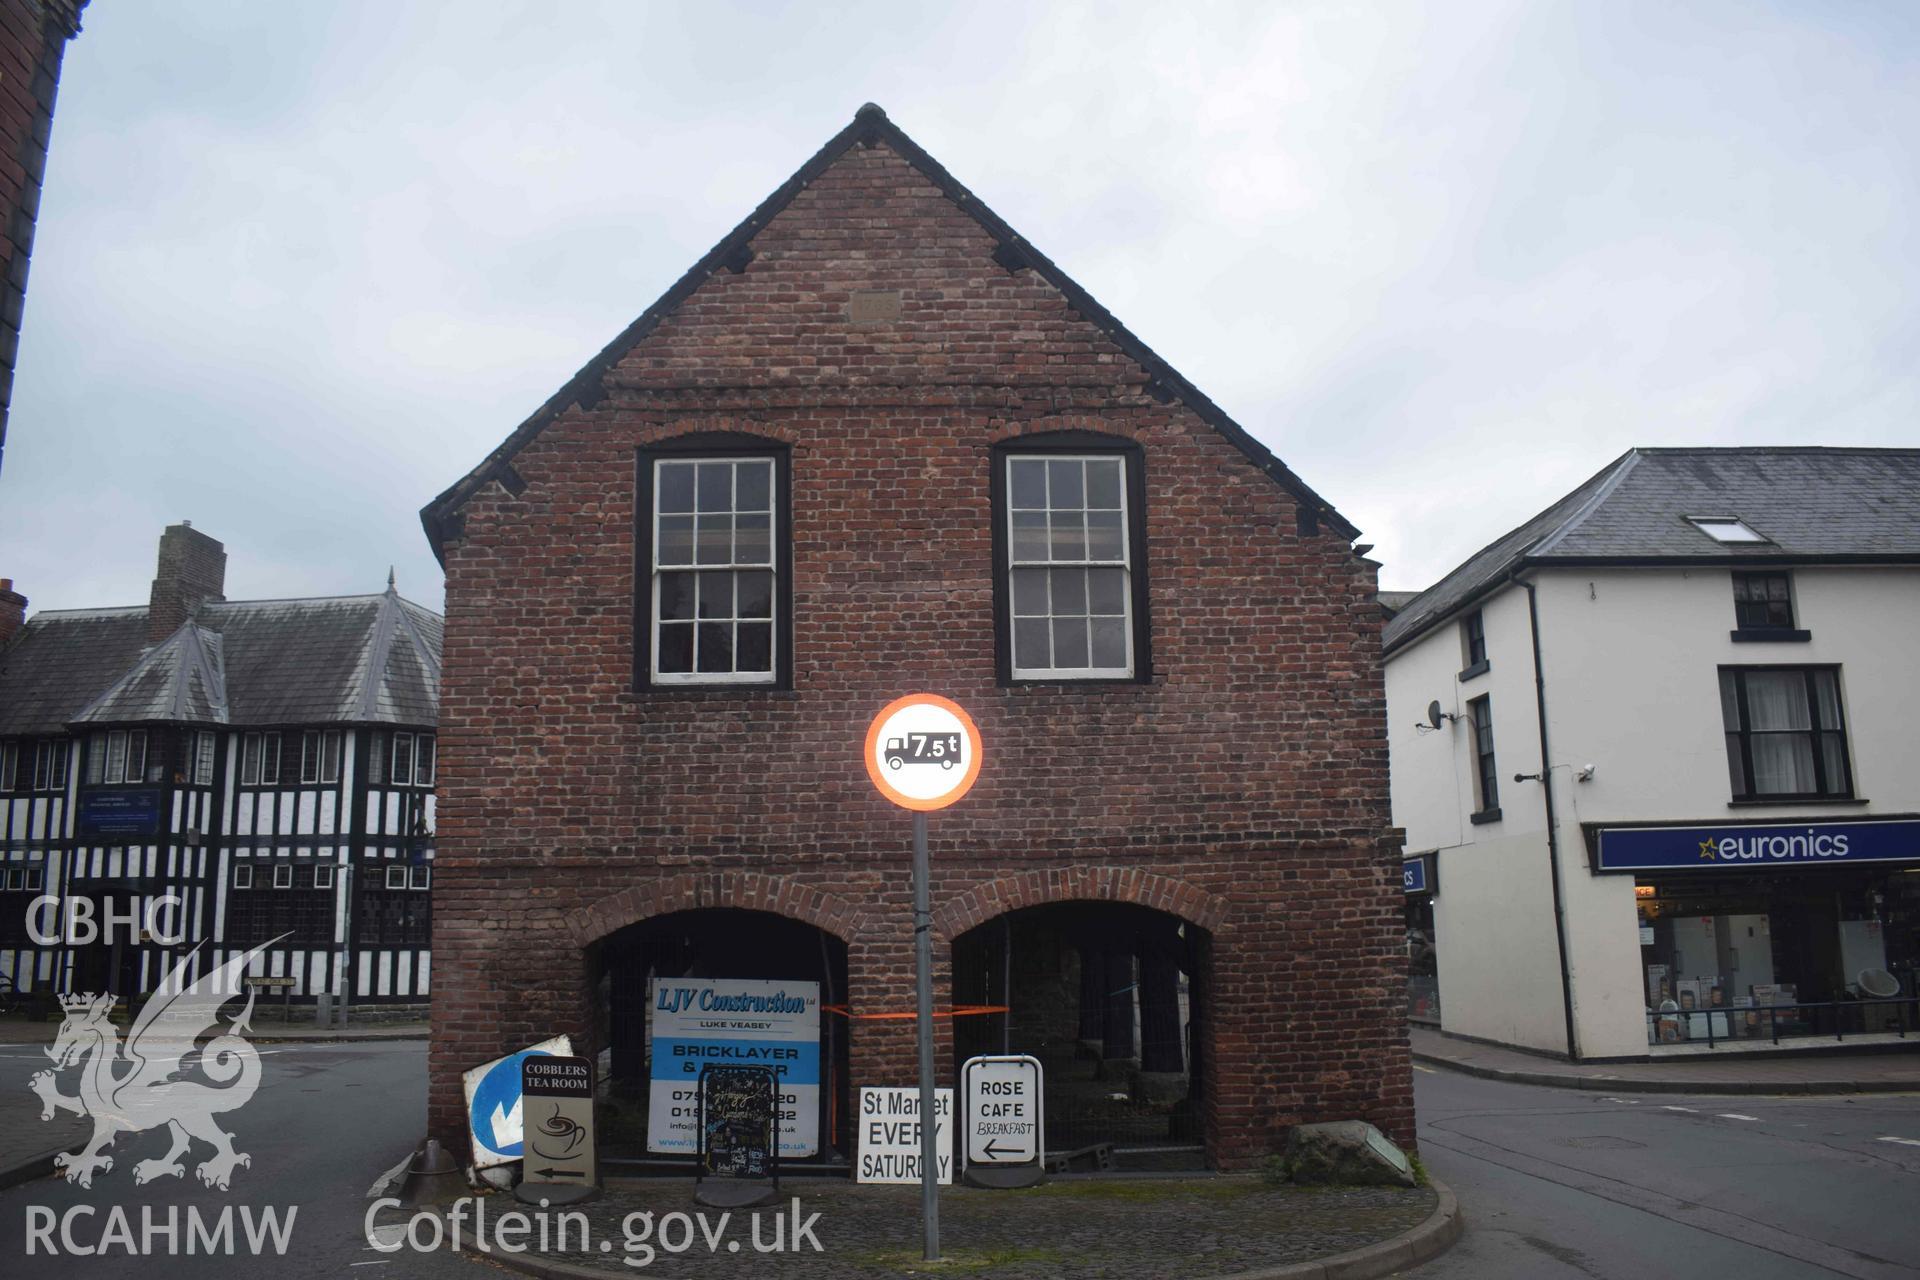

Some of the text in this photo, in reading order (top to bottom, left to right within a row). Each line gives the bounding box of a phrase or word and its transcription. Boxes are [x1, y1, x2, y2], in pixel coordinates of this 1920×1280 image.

[1718, 828, 1849, 860] euronics
[657, 988, 697, 1013] LJV
[699, 988, 805, 1014] Construction
[730, 1022, 772, 1030] VEASEY
[673, 1045, 798, 1060] BRICKLAYER
[526, 1064, 587, 1076] COBBLERS
[683, 1062, 696, 1073] &
[526, 1077, 587, 1089] TEA ROOM
[981, 1082, 1024, 1095] ROSE
[864, 1092, 948, 1115] St Maret
[981, 1103, 1024, 1117] CAFE
[976, 1122, 1035, 1136] BREAKFAST
